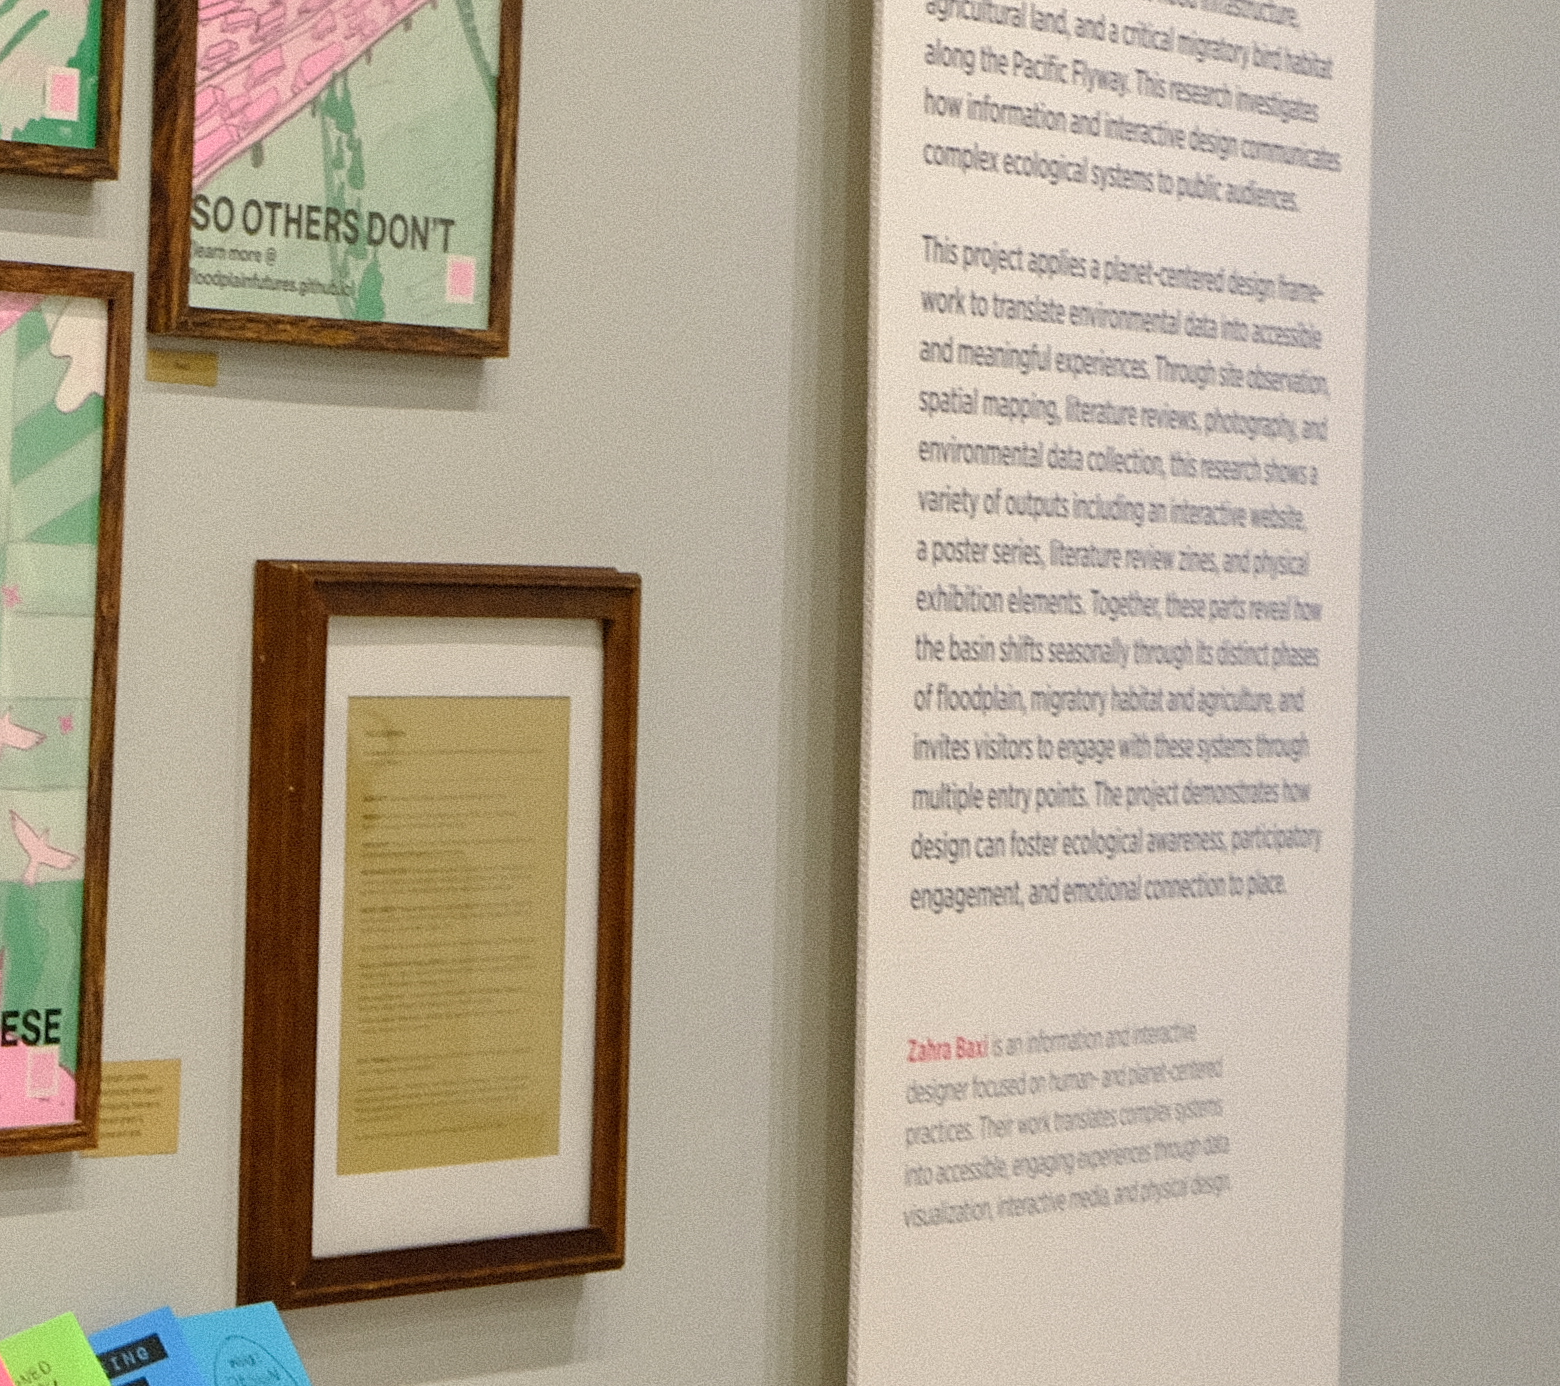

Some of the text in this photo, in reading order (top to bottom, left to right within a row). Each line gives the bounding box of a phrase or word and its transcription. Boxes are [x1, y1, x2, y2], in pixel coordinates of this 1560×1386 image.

[923, 141, 1089, 186] complex ecological
[190, 194, 456, 253] SO OTHERS DON'T
[921, 234, 1023, 276] This project
